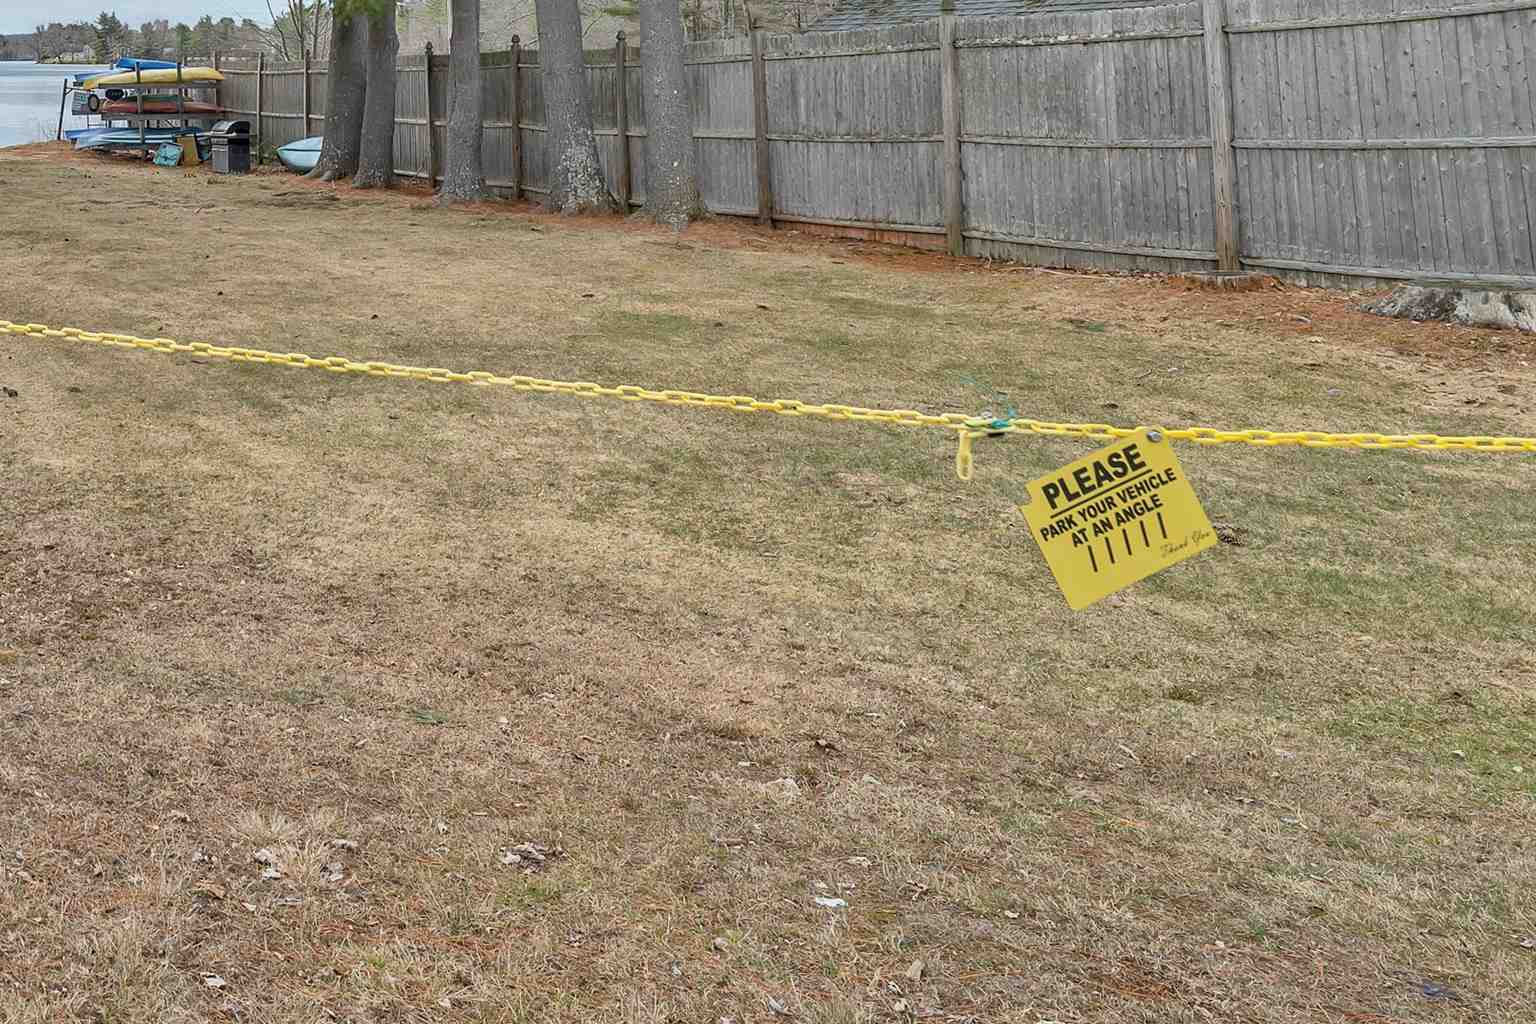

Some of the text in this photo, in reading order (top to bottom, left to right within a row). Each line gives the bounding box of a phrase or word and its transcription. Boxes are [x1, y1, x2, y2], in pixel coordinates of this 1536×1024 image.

[1040, 468, 1177, 541] PARK YOUR VEHICLE
[1041, 443, 1146, 510] PLEASE
[1071, 494, 1163, 548] AT AN ANGLE
